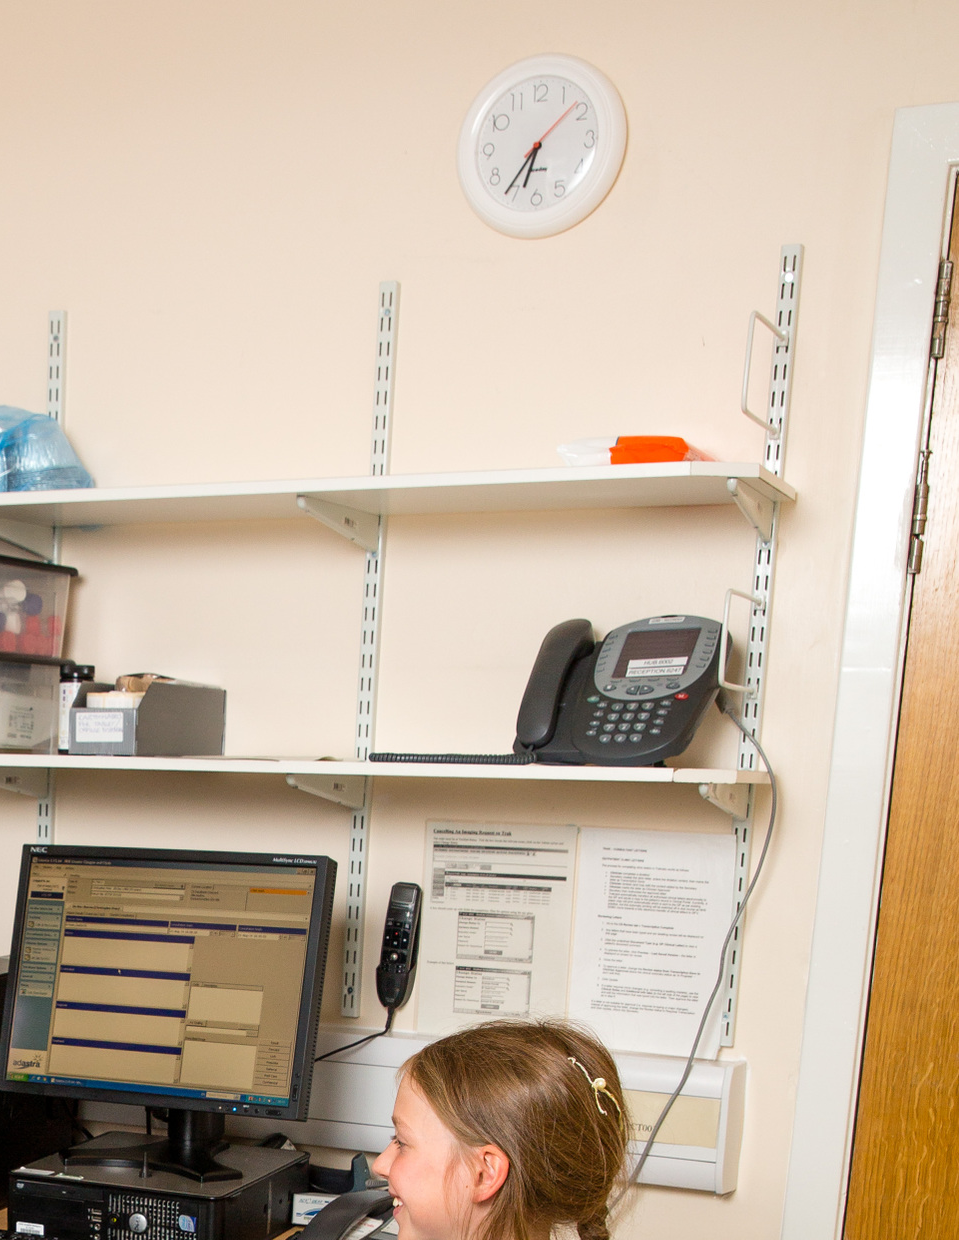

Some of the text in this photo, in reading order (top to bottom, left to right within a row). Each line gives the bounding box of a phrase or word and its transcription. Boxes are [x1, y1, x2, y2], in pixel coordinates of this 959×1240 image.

[510, 84, 566, 111] 11 12 1
[492, 102, 588, 132] 10 2
[482, 129, 596, 160] 9 3
[489, 167, 501, 186] 8
[530, 188, 543, 206] 6
[553, 179, 566, 198] 5
